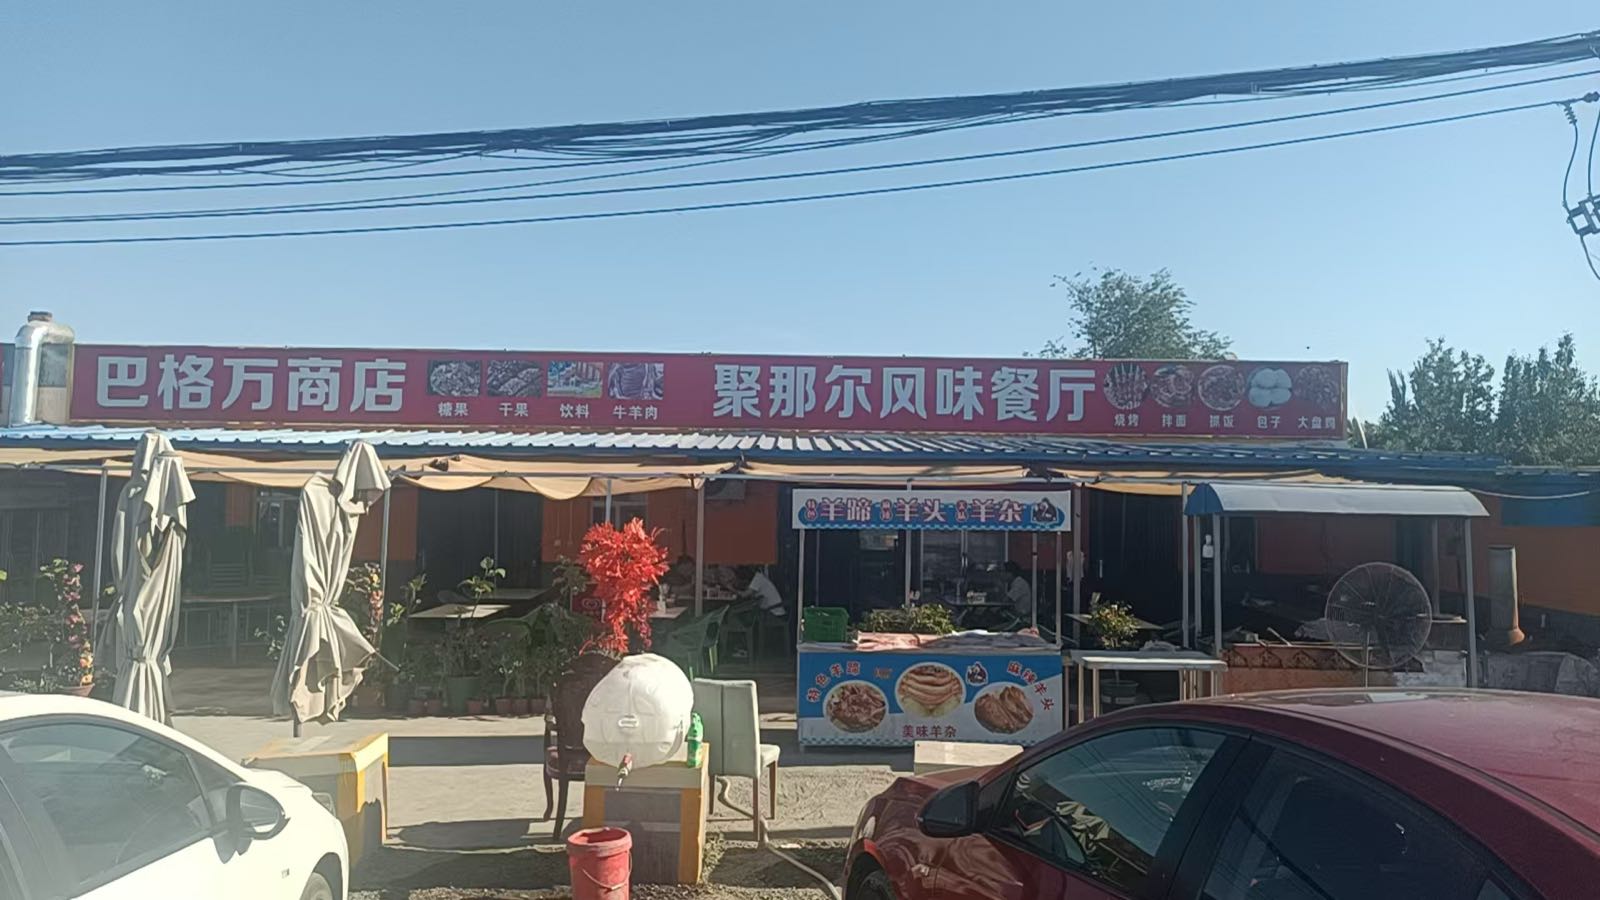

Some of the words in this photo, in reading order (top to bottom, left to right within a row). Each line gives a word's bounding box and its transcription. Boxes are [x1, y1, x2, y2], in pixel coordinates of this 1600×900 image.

[96, 354, 407, 412] 巴格万商店
[713, 364, 1096, 421] 聚那尔风味餐厅
[438, 402, 469, 417] 糖果
[499, 402, 529, 417] 干果
[560, 403, 590, 418] 饮料
[613, 404, 658, 420] 牛羊肉
[1114, 414, 1139, 427] 烧烤
[1256, 415, 1281, 429] 包子
[820, 497, 872, 522] 羊蹄
[895, 497, 946, 522] 羊头
[971, 499, 1022, 523] 羊杂
[902, 724, 957, 738] 美味羊杂
